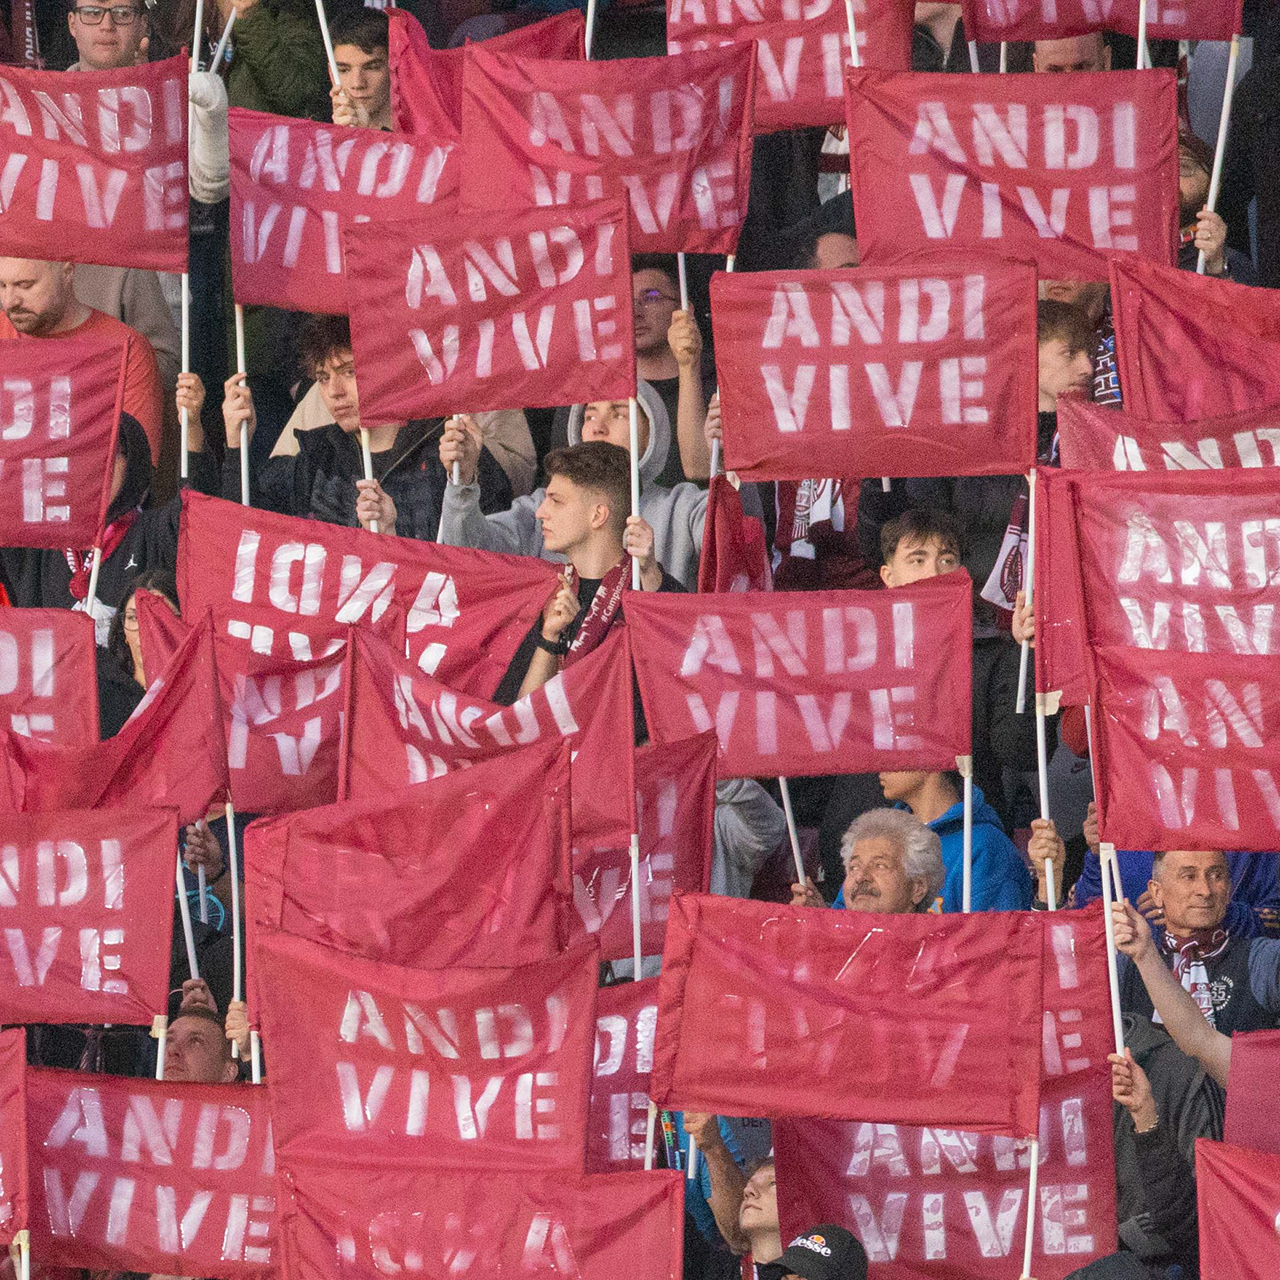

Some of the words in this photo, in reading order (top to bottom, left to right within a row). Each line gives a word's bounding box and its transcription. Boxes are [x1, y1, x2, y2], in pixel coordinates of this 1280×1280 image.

[528, 76, 732, 156] ANDI
[909, 101, 1137, 170] ANDI
[250, 125, 454, 202] ANDI
[909, 173, 1138, 251] VIVE
[406, 222, 615, 308] ANDI
[409, 295, 622, 385] VIVE
[761, 274, 985, 349] ANDI
[761, 357, 989, 432] VIVE
[682, 602, 914, 677] ANDI
[687, 687, 918, 756] VIVE
[340, 989, 569, 1060] ANDI
[44, 1086, 276, 1176] ANDI
[336, 1062, 560, 1140] VIVE
[42, 1168, 275, 1265] VIVE
[848, 1184, 1093, 1262] VIVE
